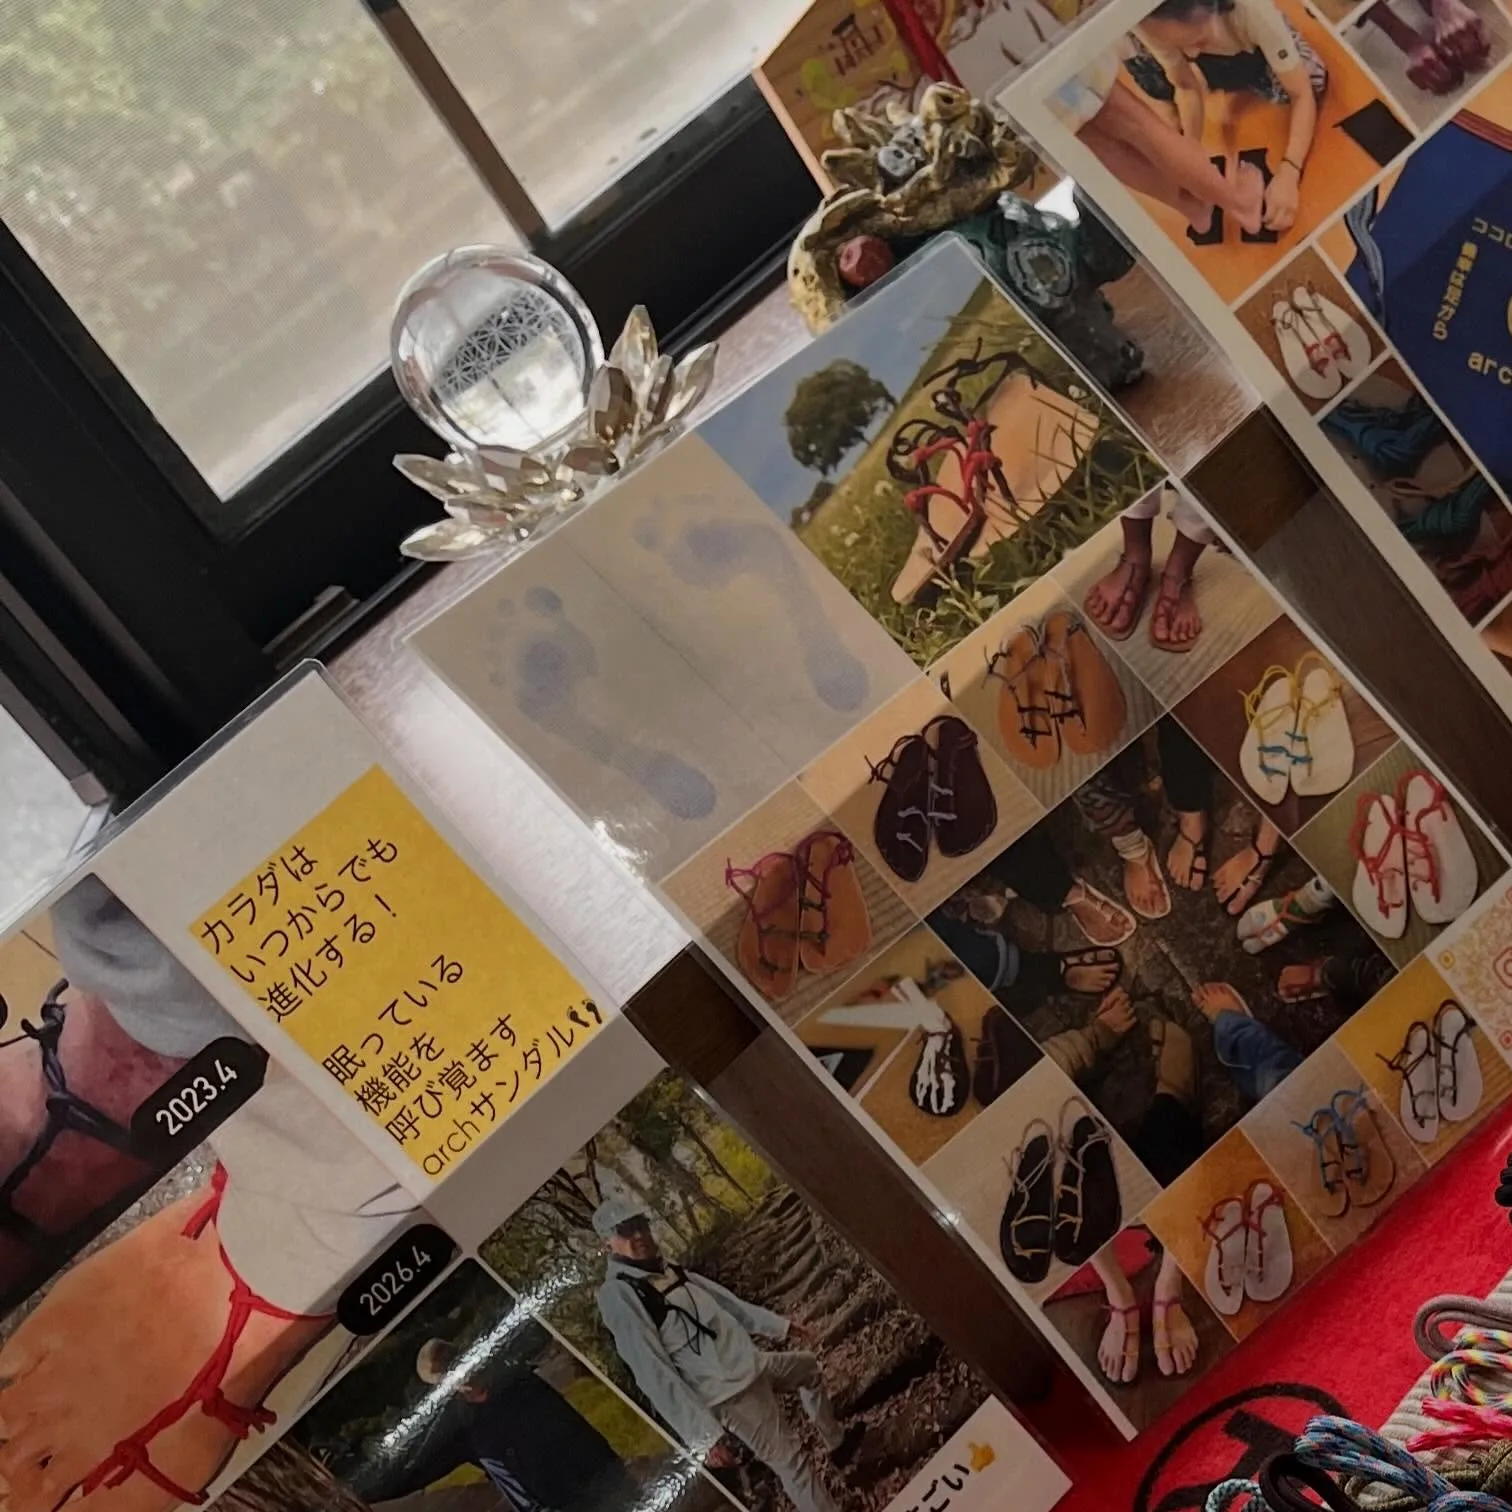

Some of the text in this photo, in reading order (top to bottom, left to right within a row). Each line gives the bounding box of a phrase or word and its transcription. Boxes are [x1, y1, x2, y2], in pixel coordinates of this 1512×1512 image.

[200, 844, 318, 955] カラダは
[230, 837, 399, 983] いつからでも
[322, 953, 465, 1087] 眠っている
[354, 1031, 445, 1115] 機能を
[155, 1058, 240, 1136] 2023.4
[384, 1014, 520, 1146] 呼び覚ます
[359, 1244, 433, 1318] 2026.4
